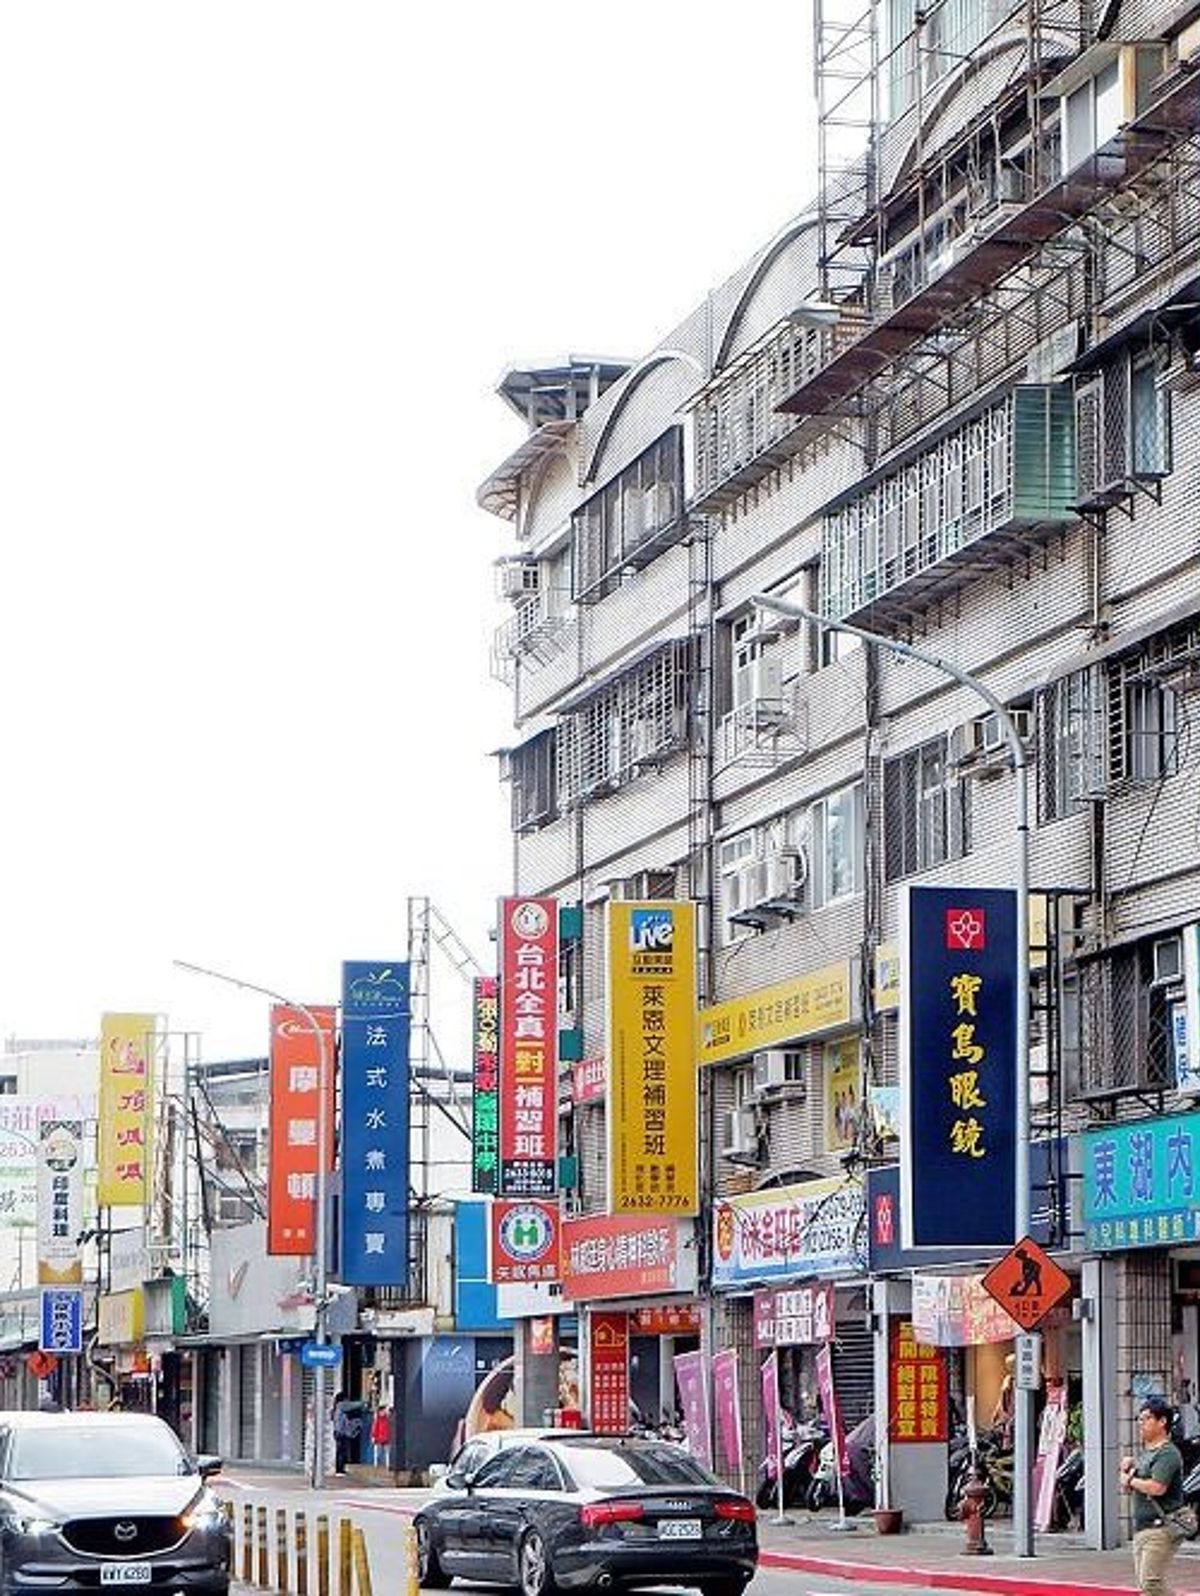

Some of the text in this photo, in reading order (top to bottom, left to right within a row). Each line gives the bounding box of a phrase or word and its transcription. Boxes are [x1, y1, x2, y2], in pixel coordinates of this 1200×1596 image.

[365, 1025, 388, 1255] 法式水煮專賣
[514, 943, 546, 1159] 台北全真一對一補習班
[641, 984, 667, 1157] 萊恩文理補習班
[949, 973, 987, 1159] 寶島眼鏡
